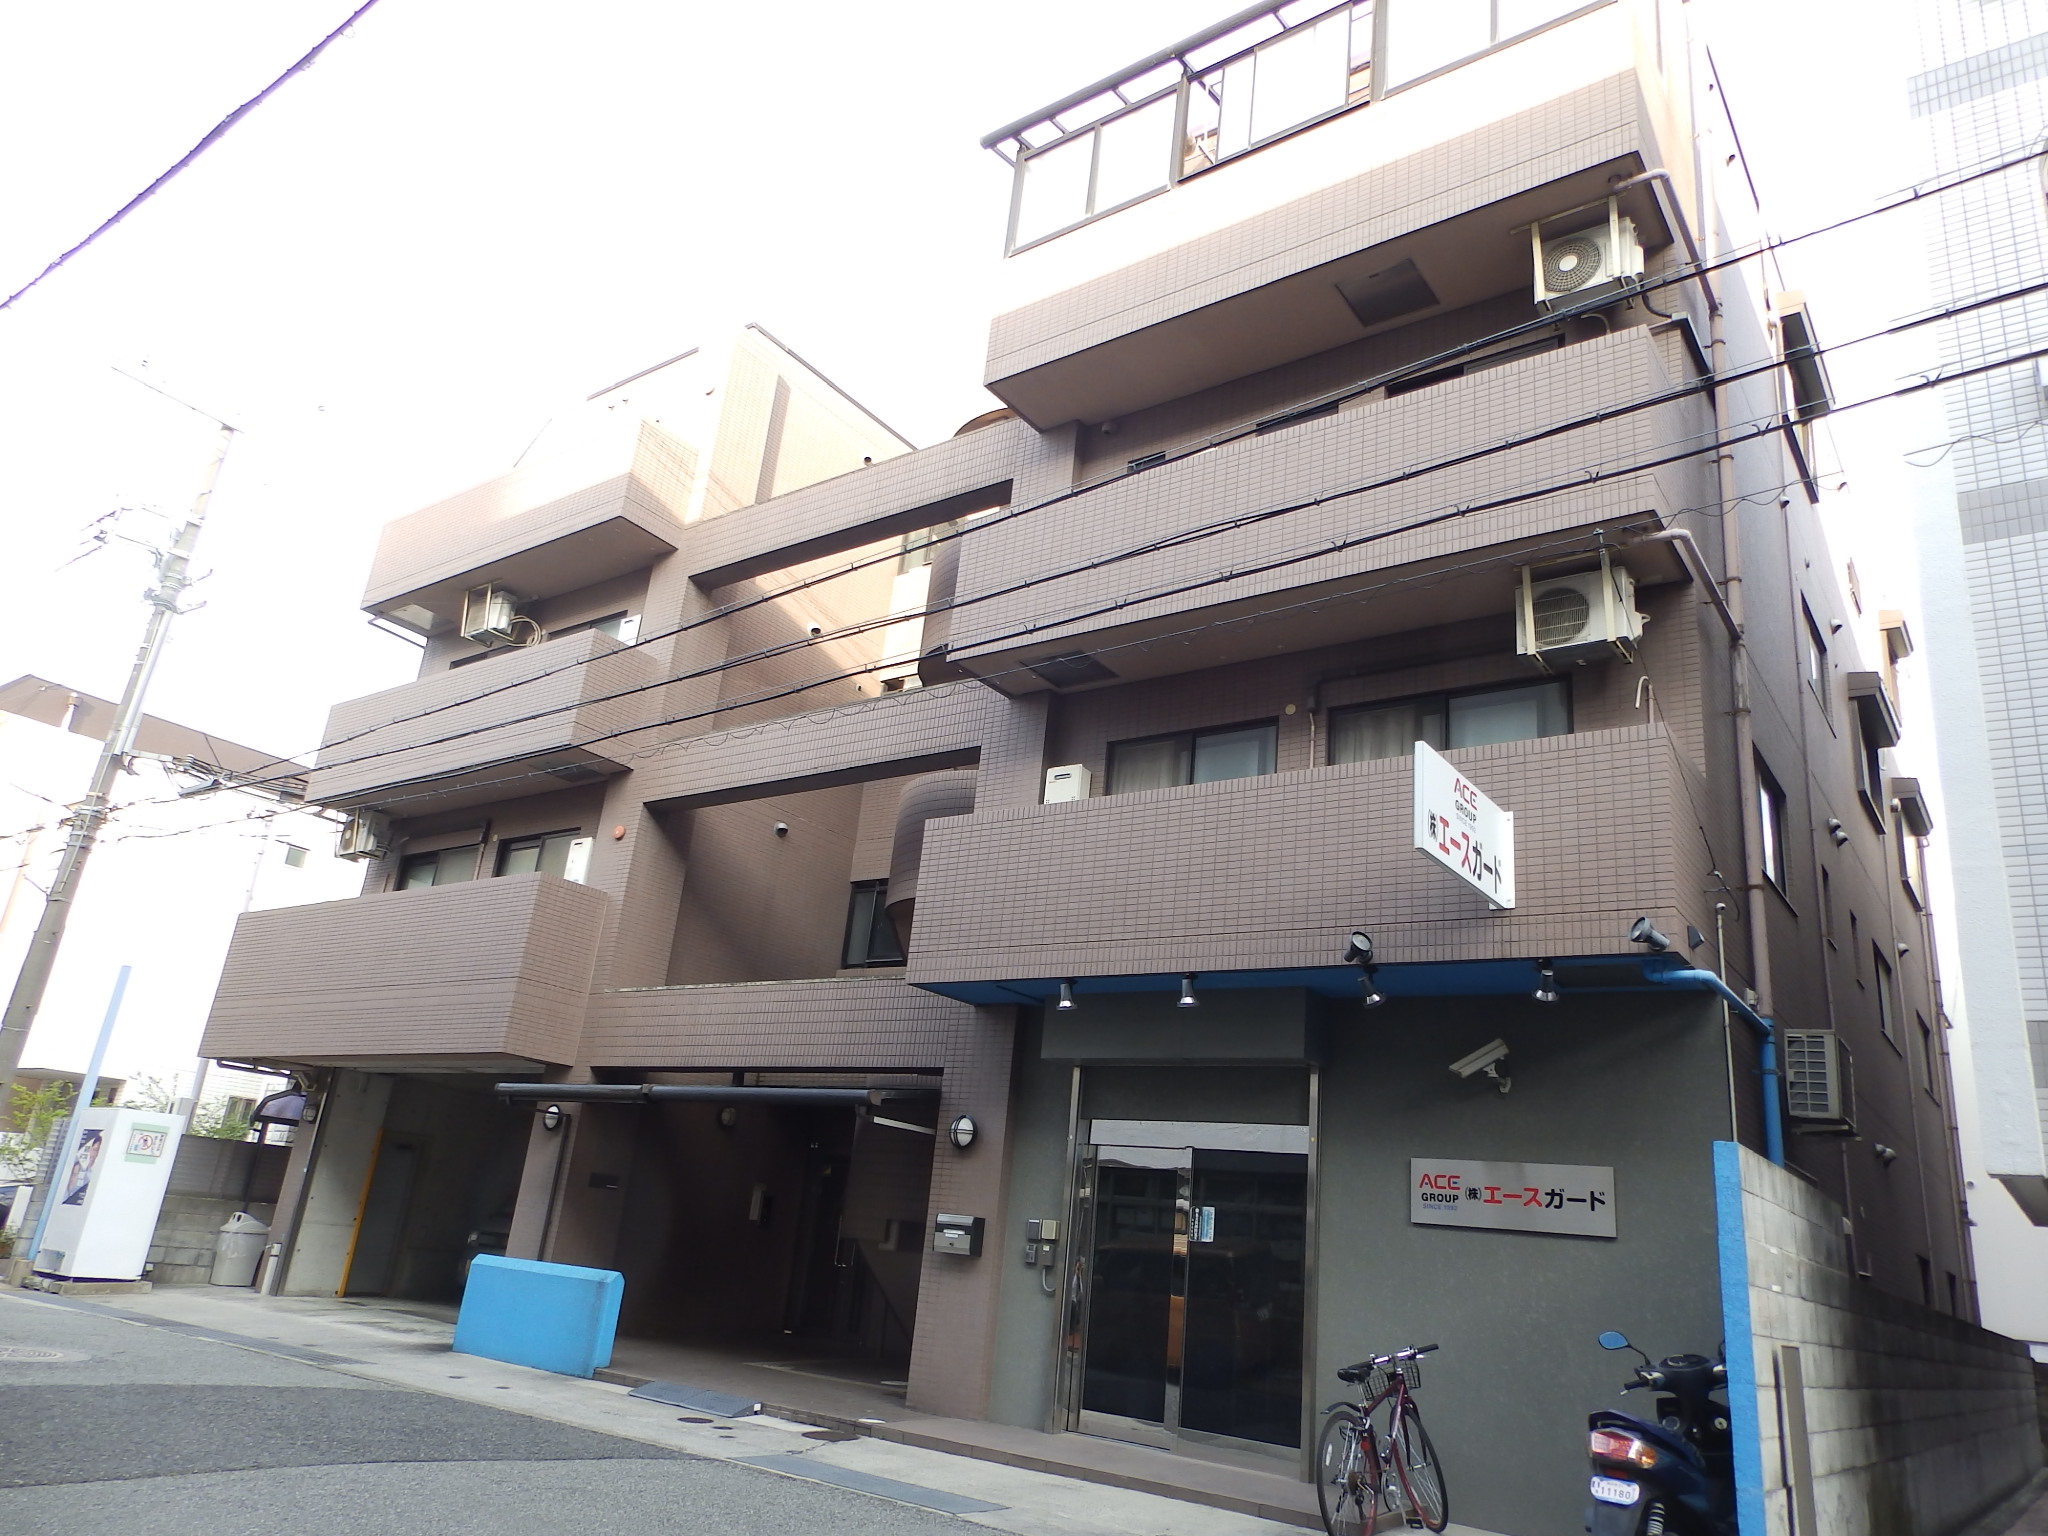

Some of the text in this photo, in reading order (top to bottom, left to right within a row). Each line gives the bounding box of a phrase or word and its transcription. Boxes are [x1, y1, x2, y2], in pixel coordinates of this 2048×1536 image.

[1453, 777, 1478, 811] ACE
[1454, 799, 1477, 823] GROUP
[1419, 1173, 1461, 1191] ACE
[1421, 1192, 1459, 1204] GROUP
[1422, 1203, 1442, 1211] SINCE
[1601, 1486, 1631, 1500] 11180
